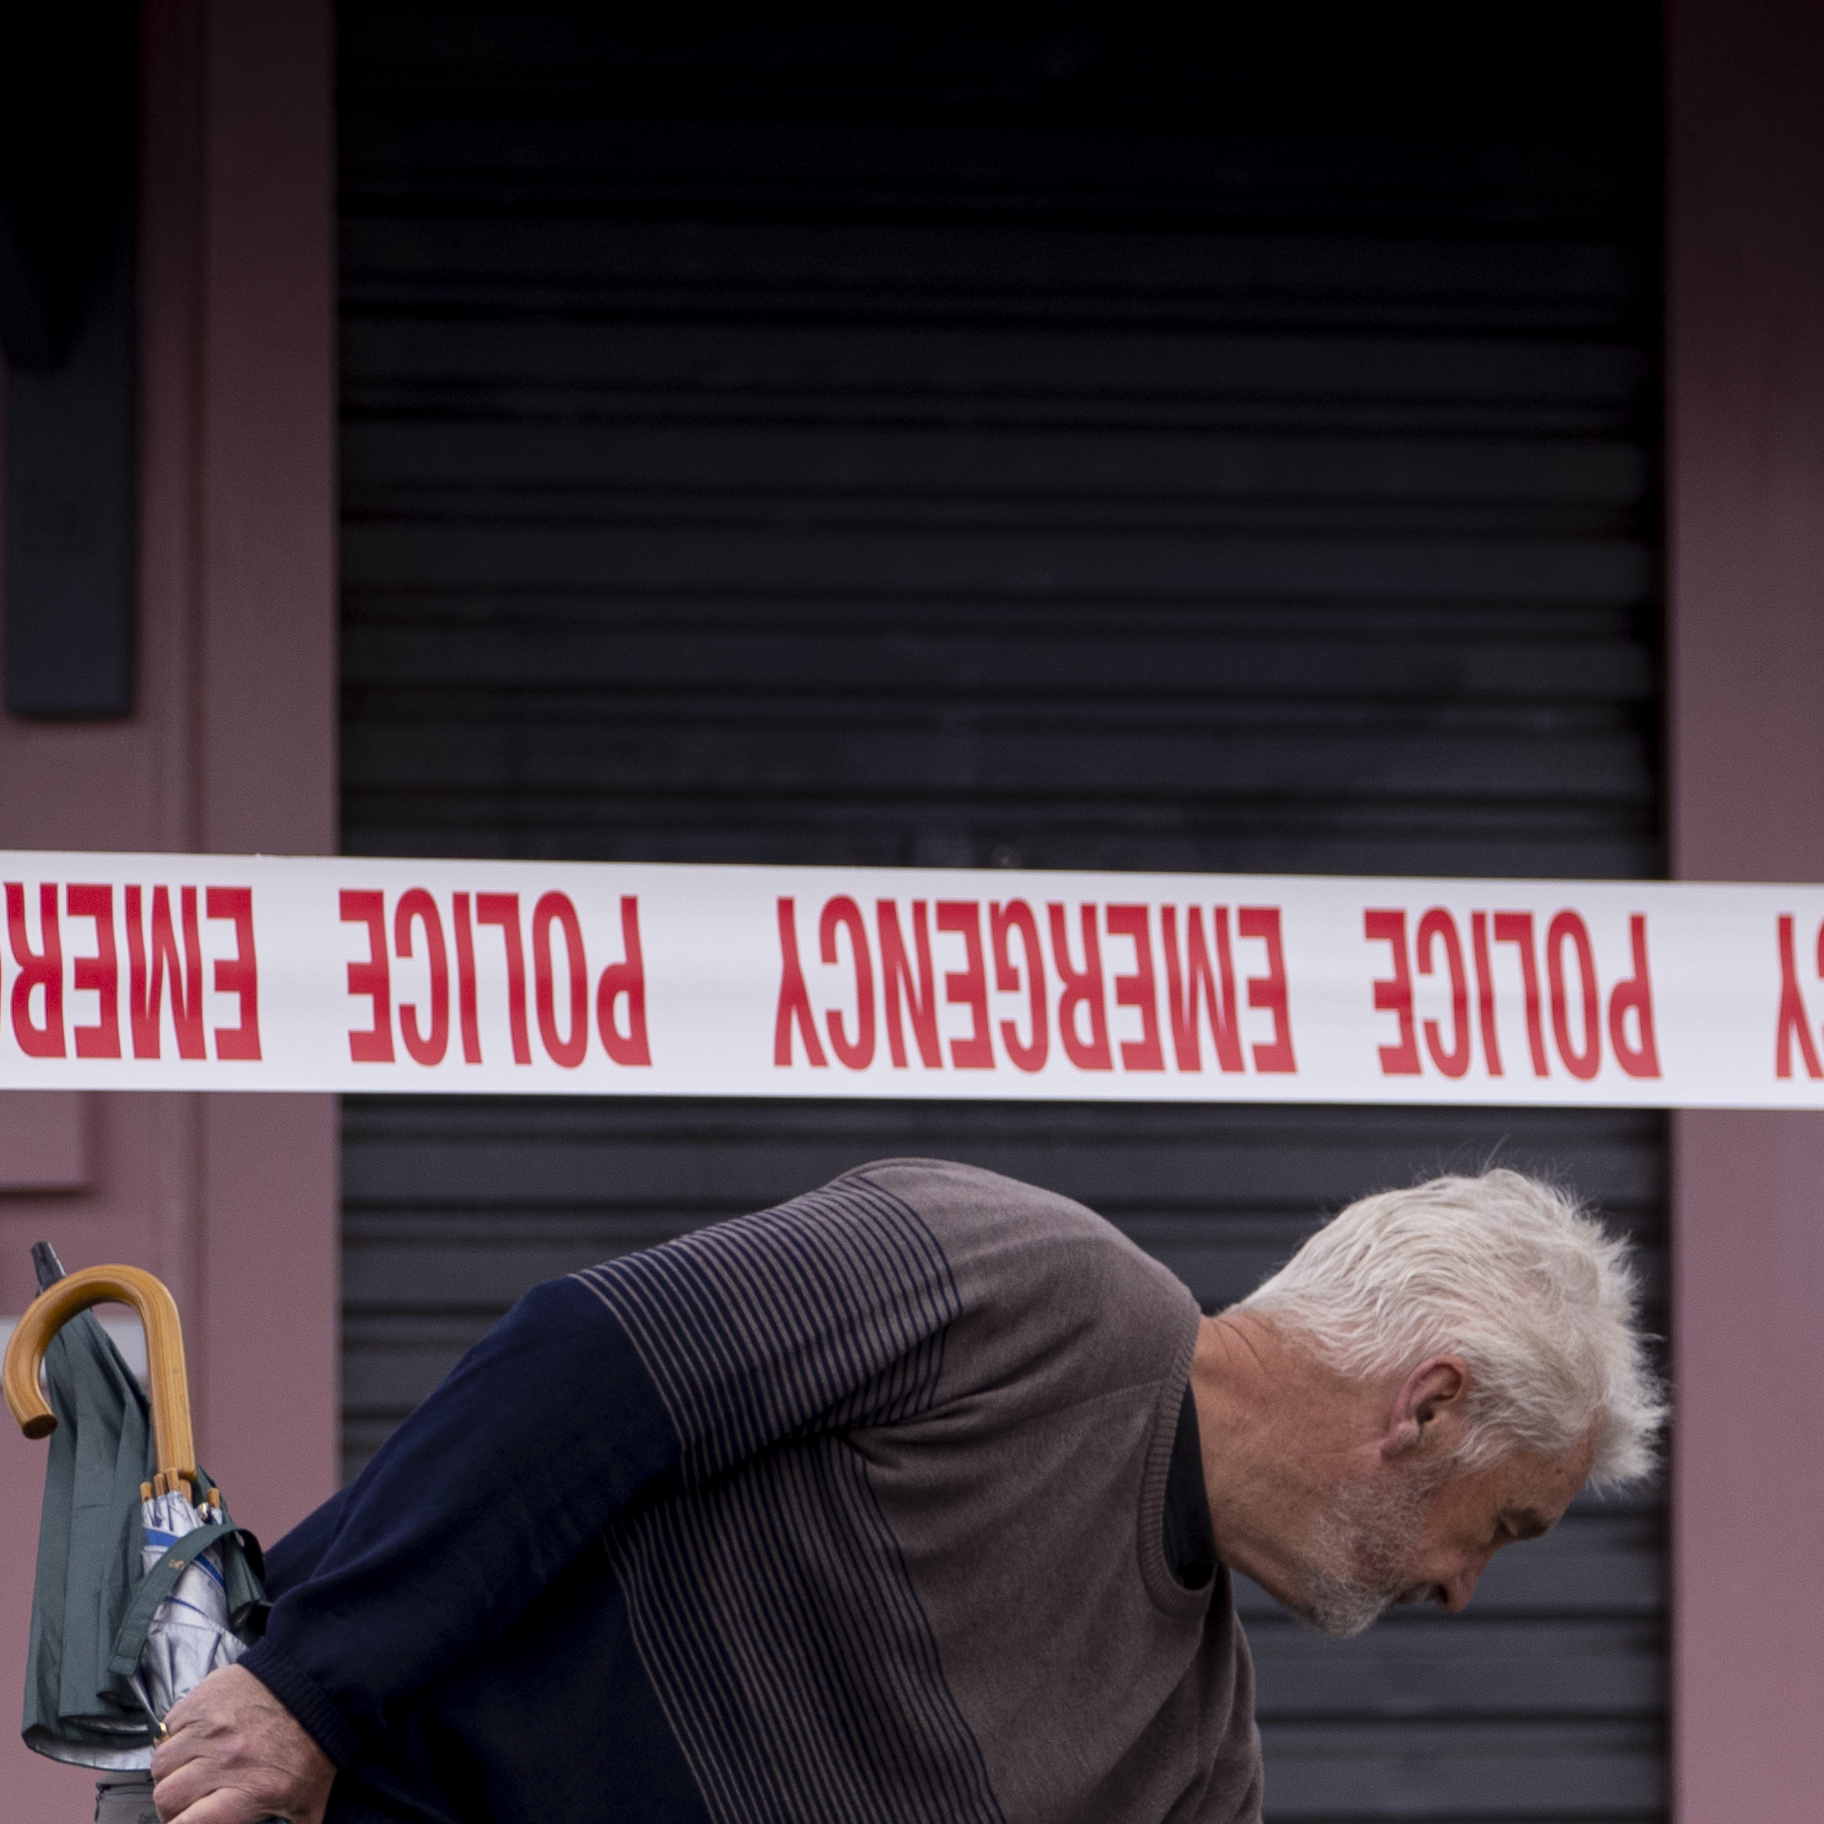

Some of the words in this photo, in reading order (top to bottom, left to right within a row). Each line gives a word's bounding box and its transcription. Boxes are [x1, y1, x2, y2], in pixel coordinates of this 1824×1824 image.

[338, 889, 652, 1069] POLICE
[773, 895, 1297, 1075] EMERGENCY
[1363, 908, 1661, 1081] POLICE
